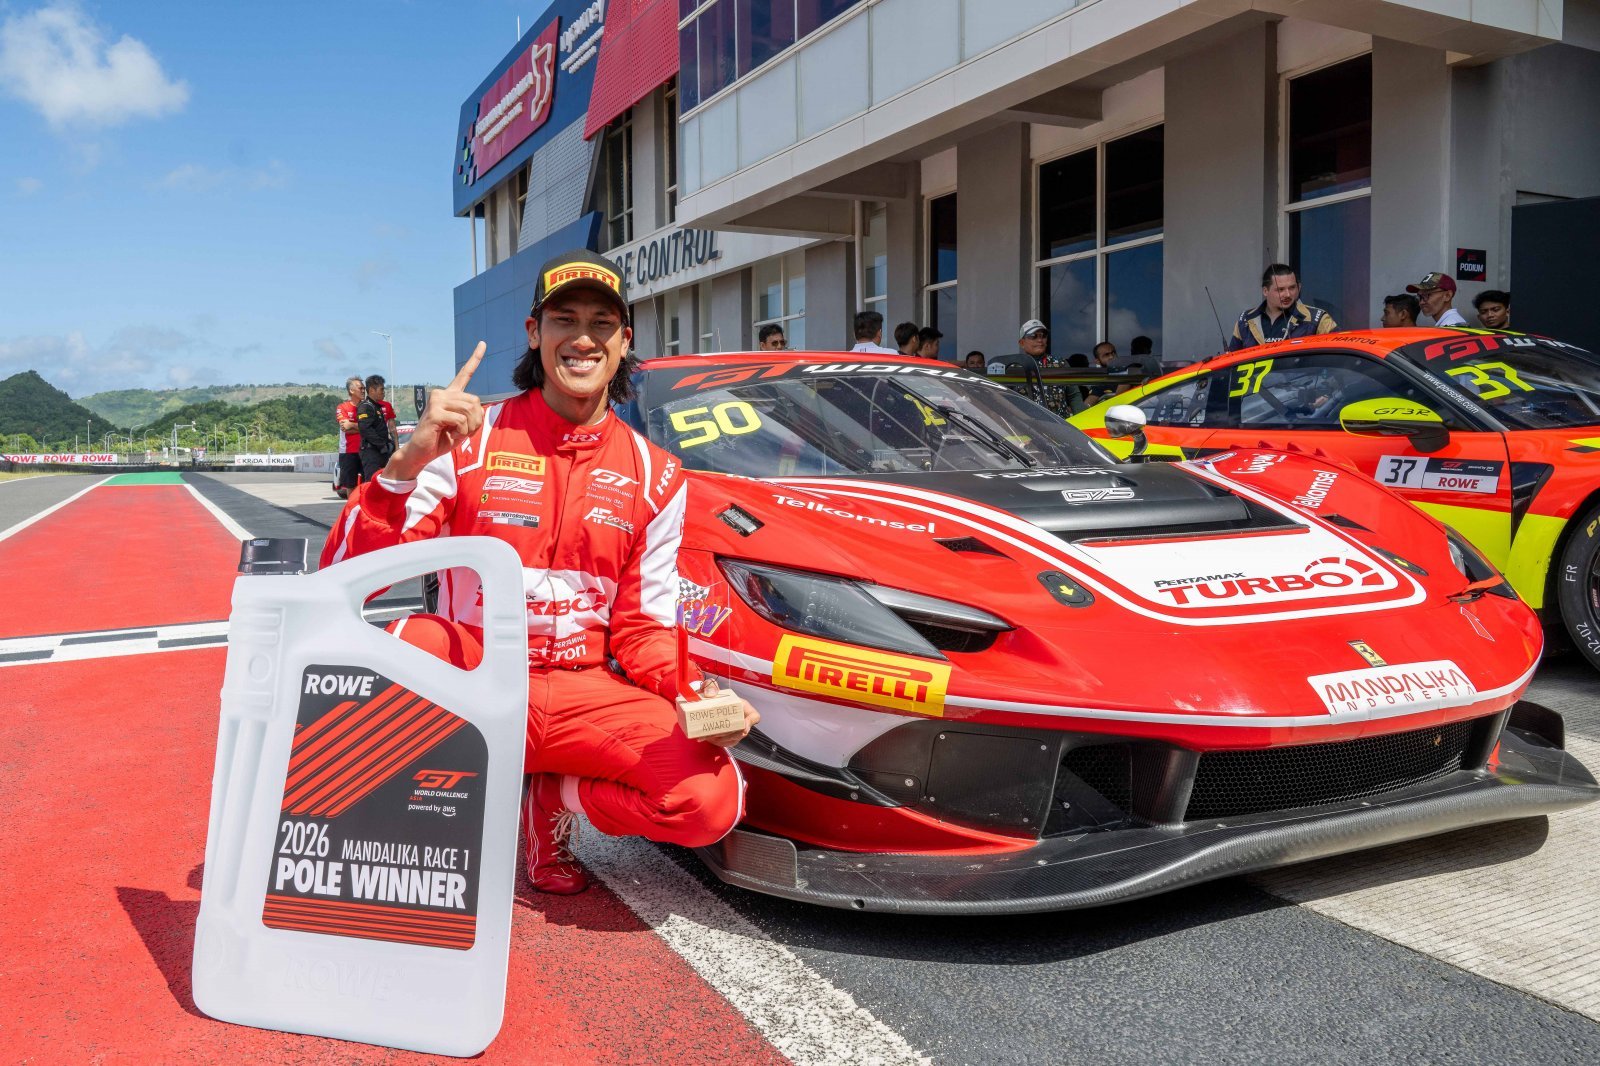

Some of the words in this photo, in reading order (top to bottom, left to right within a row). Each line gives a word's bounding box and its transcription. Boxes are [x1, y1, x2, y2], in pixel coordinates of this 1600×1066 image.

[637, 228, 719, 285] CONTROL
[1460, 263, 1484, 272] PODIUM
[549, 265, 616, 289] PIRELLI
[671, 362, 829, 391] GT
[1229, 359, 1274, 398] 37
[1444, 361, 1536, 401] 37
[1423, 371, 1479, 414] www.porsche.com
[669, 401, 762, 449] 50
[43, 454, 76, 463] ROWE
[81, 454, 114, 463] ROWE
[490, 455, 541, 472] PIRELLI
[1384, 458, 1418, 485] 37
[656, 458, 676, 496] HRX
[1291, 469, 1339, 508] Telkomsel
[1438, 477, 1480, 489] ROWE
[772, 494, 936, 534] Telkomsel
[1154, 572, 1246, 588] PERTAMAX
[1565, 564, 1578, 582] FR
[1158, 571, 1354, 605] TURBO
[304, 674, 376, 697] ROWE
[786, 646, 933, 703] PIRELLI
[1325, 668, 1470, 704] MANDALIKA
[689, 709, 715, 721] ROWE
[716, 705, 738, 716] POLE
[1331, 687, 1476, 714] INDONESIA
[702, 719, 731, 732] AWARD
[412, 769, 479, 789] GT
[436, 791, 468, 799] CHALLENGE
[433, 805, 441, 813] by
[442, 806, 456, 816] aws
[278, 820, 330, 857] 2026
[341, 839, 419, 867] MANDALIKA
[423, 846, 458, 870] RACE
[462, 850, 469, 870] 1
[275, 857, 343, 896] POLE
[350, 863, 467, 909] WINNER
